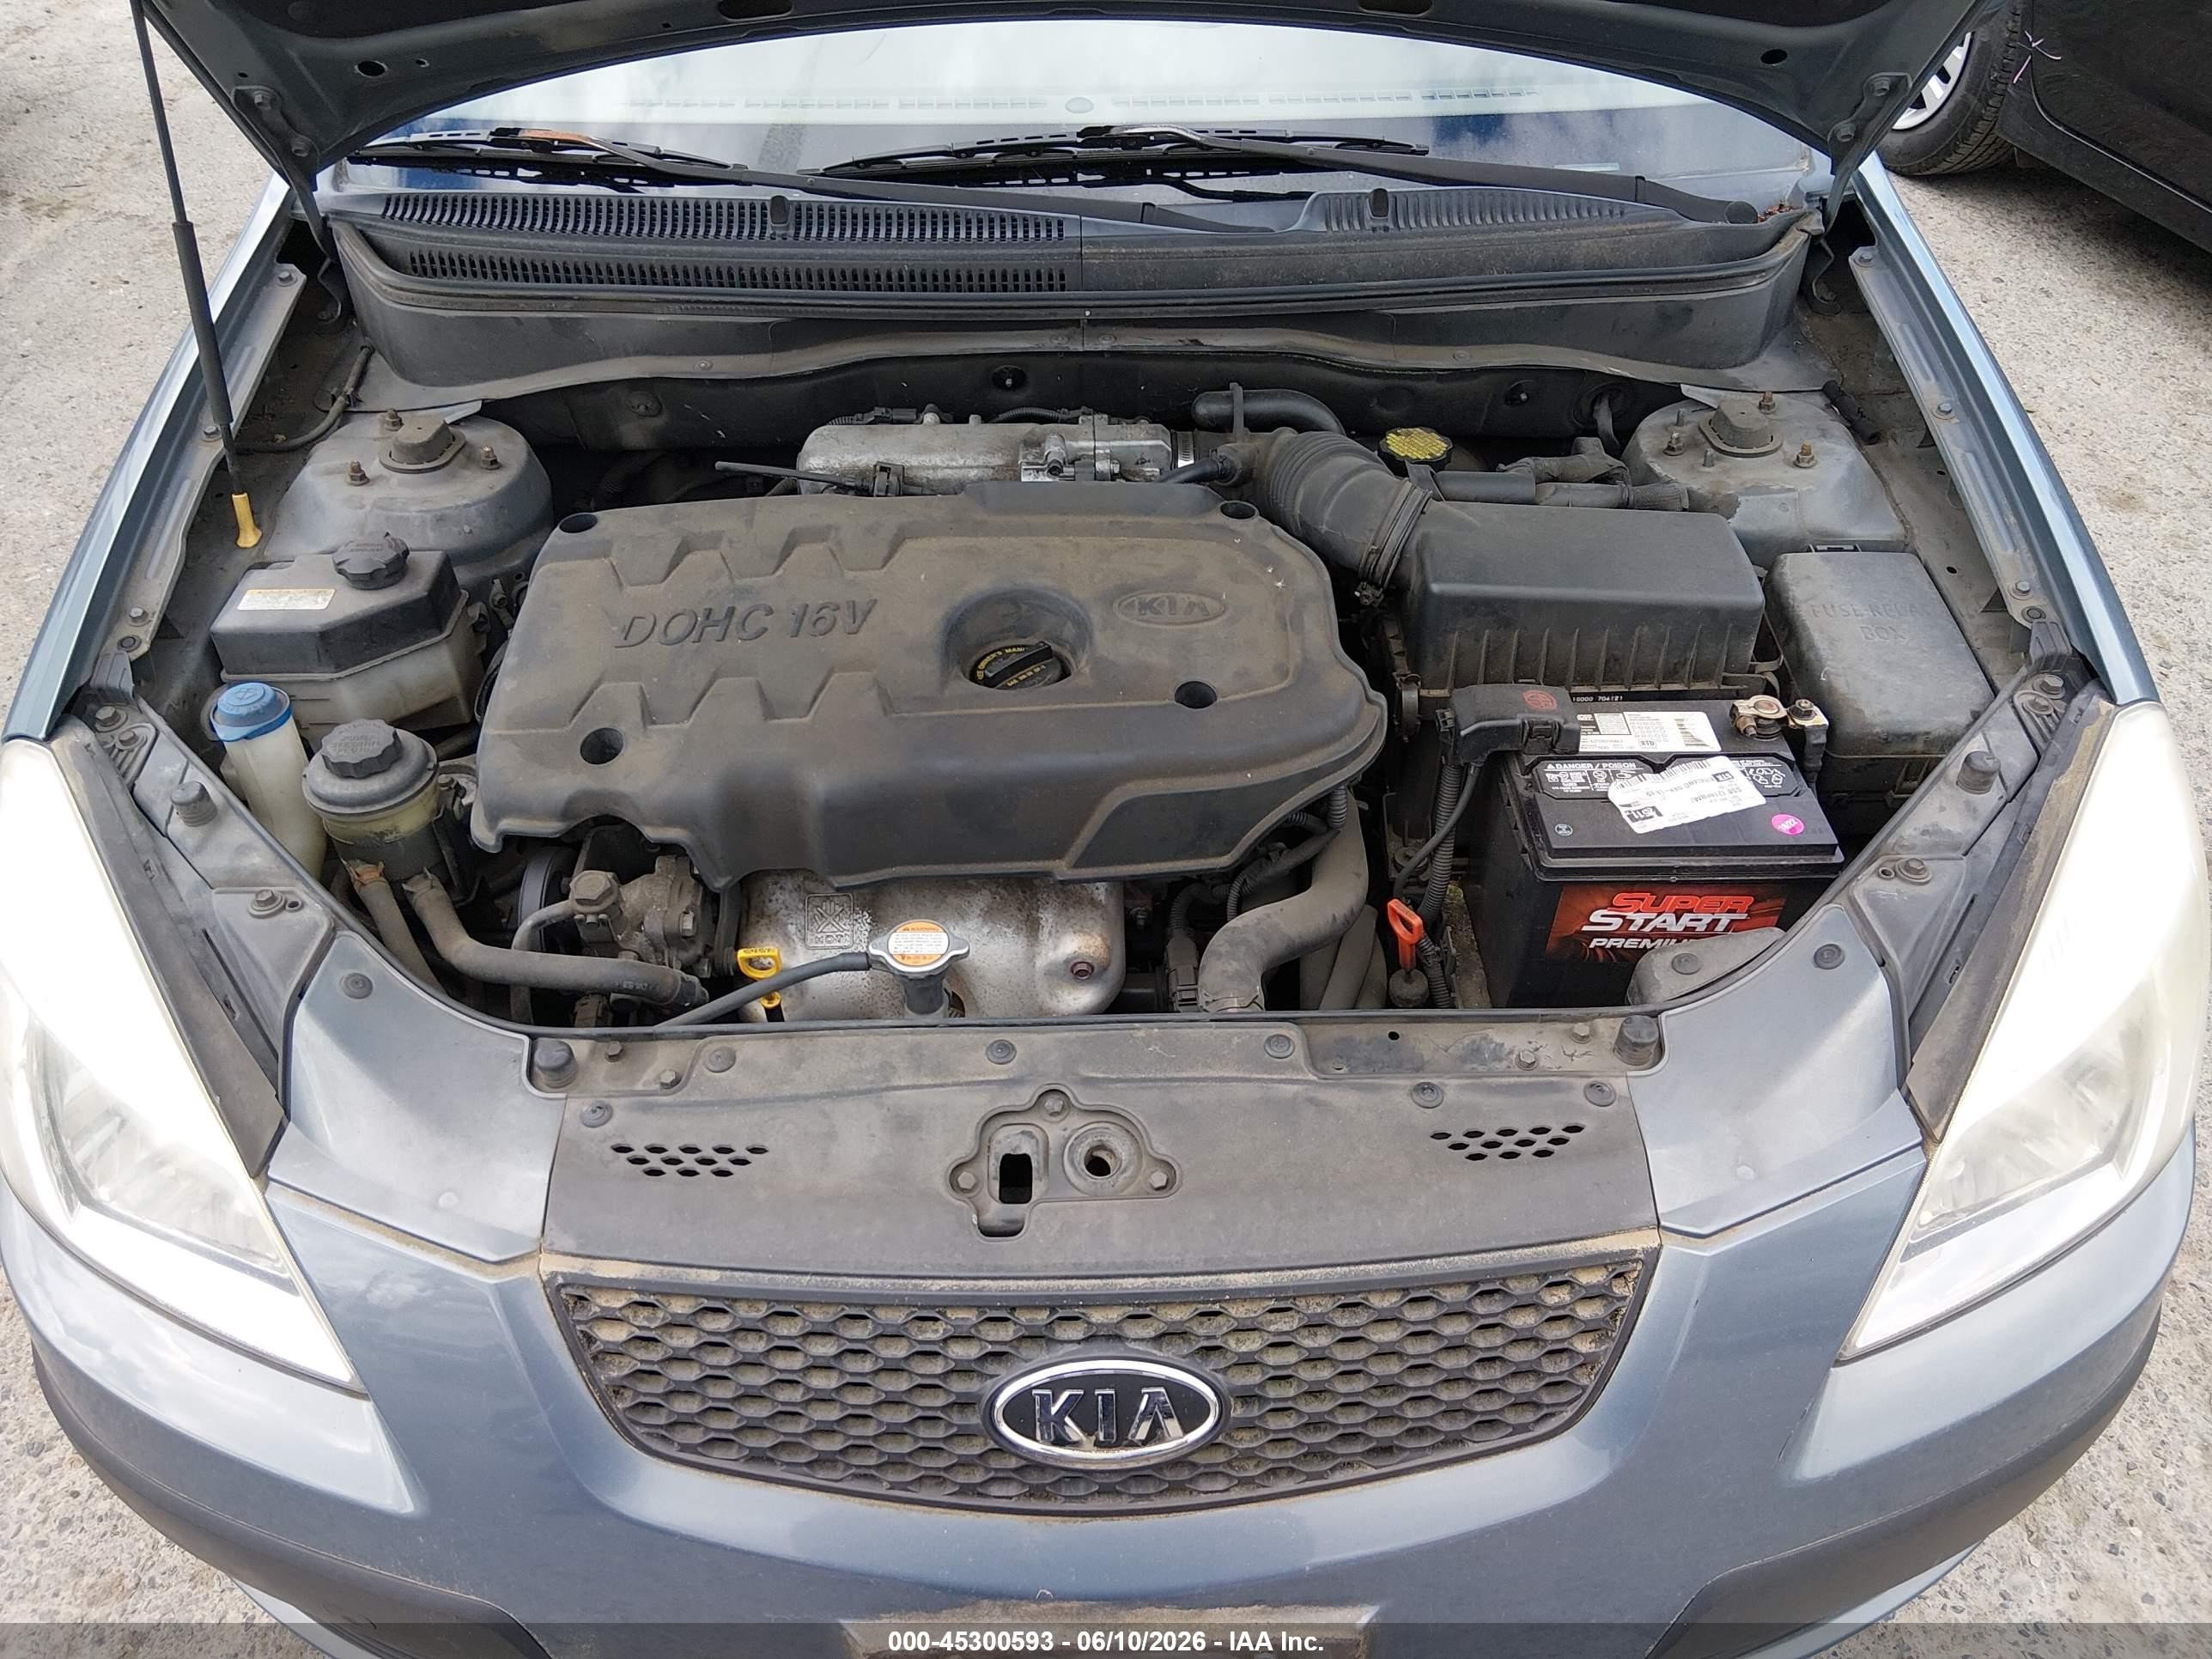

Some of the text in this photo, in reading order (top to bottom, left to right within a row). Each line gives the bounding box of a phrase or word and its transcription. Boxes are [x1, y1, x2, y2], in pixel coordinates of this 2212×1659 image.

[1137, 596, 1211, 617] KIA
[615, 599, 878, 649] DOHC 16V
[1607, 892, 1754, 913] SUPER
[1582, 908, 1748, 933] START
[1589, 938, 1691, 949] PREMIU
[1031, 1387, 1184, 1443] KIA
